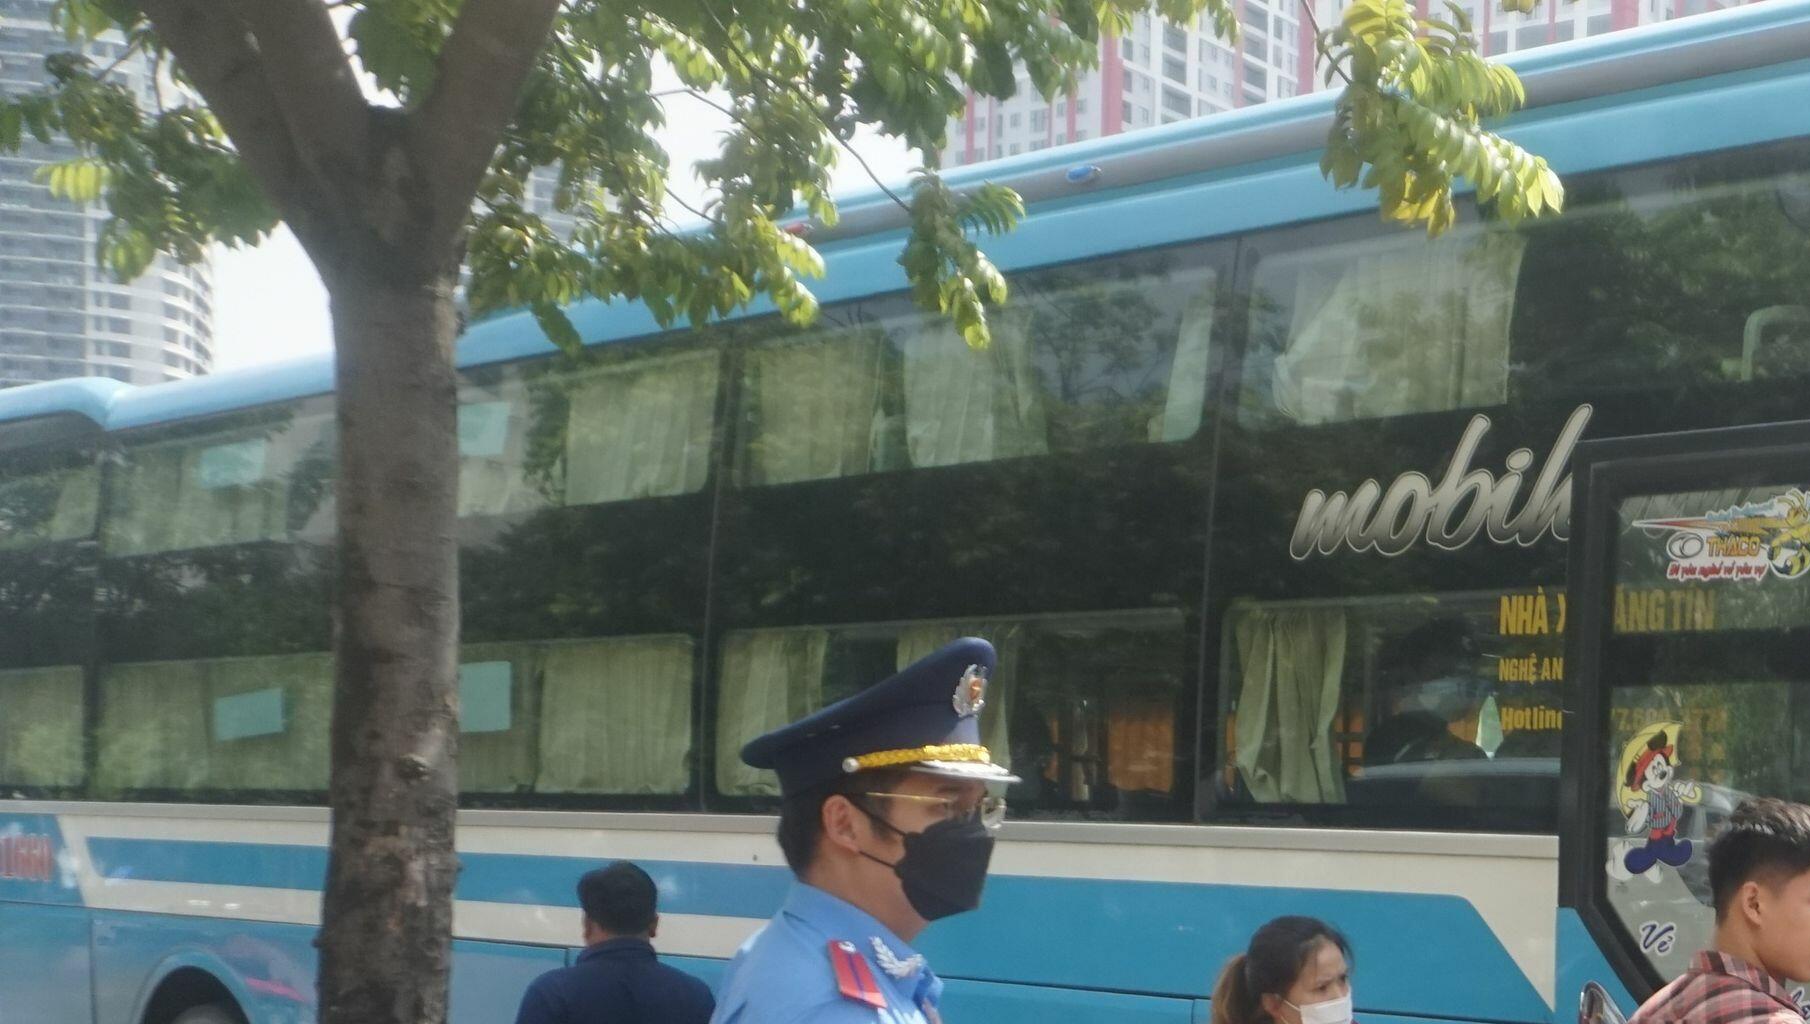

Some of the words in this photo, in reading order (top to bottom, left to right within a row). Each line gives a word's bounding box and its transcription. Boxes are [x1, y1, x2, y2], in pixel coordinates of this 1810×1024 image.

[1289, 402, 1593, 560] mobih
[1706, 536, 1761, 557] THACO
[1500, 585, 1548, 635] NHÀ
[1499, 653, 1536, 685] NGHỆ
[1541, 657, 1563, 681] AN
